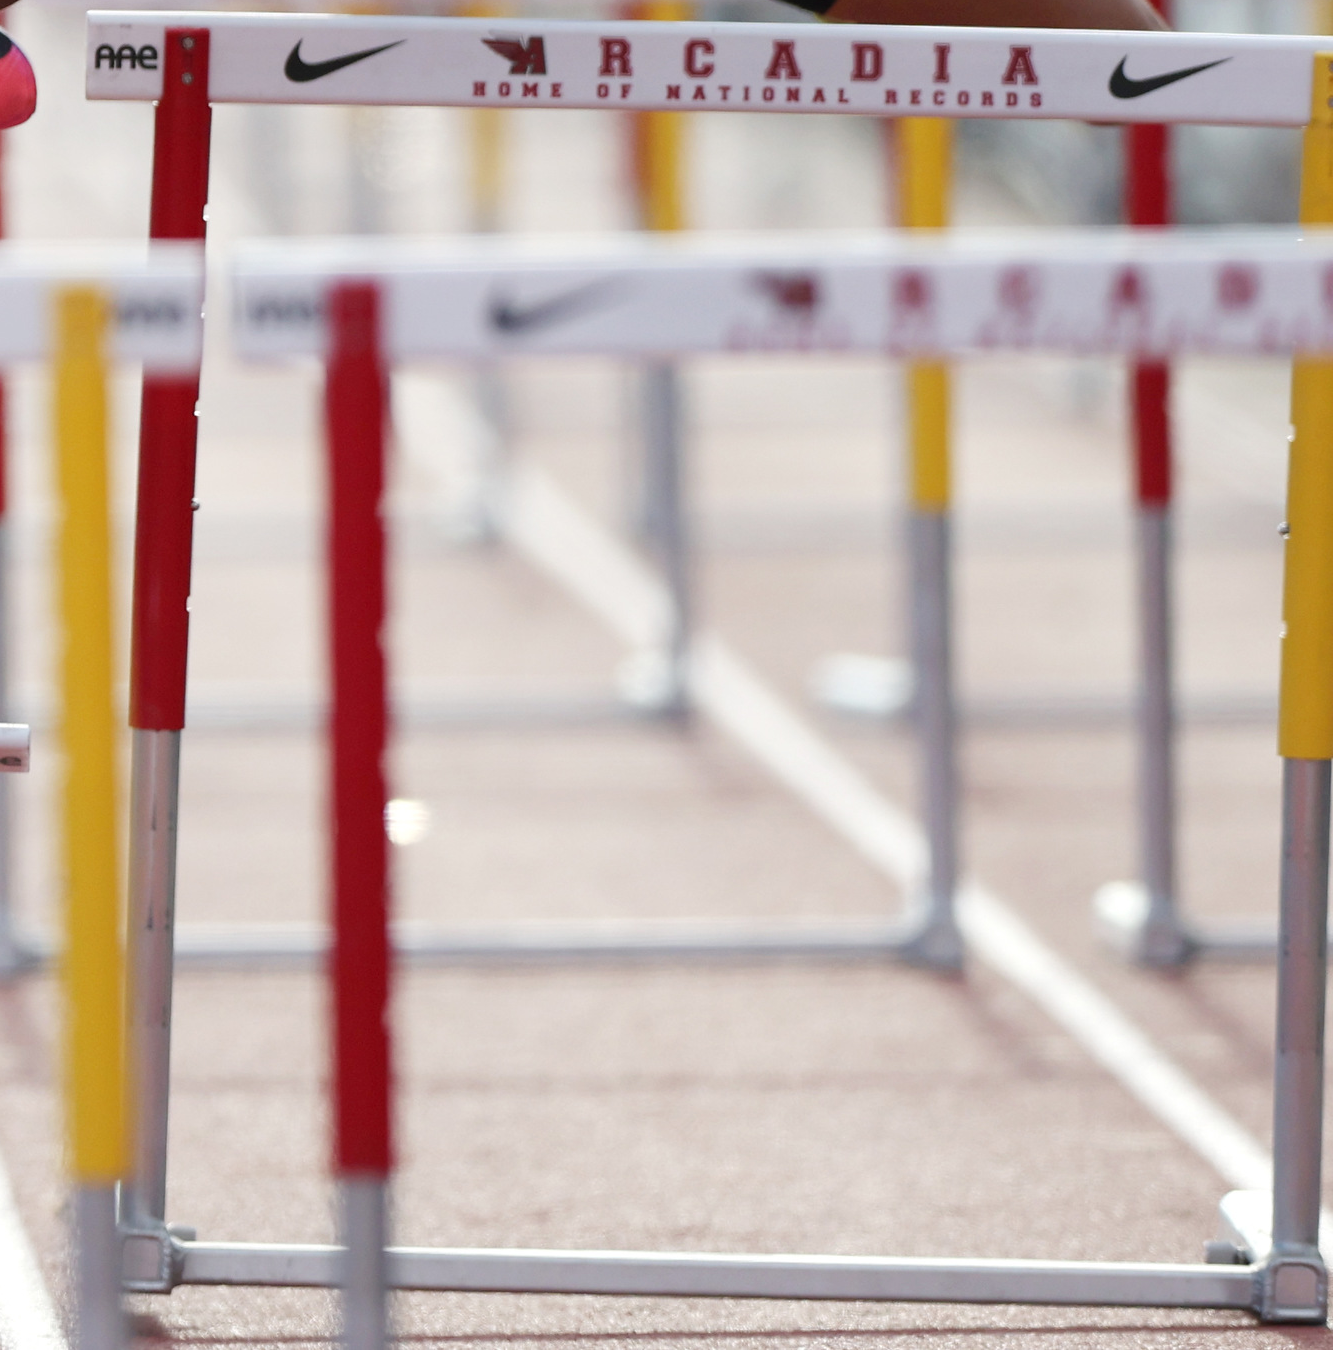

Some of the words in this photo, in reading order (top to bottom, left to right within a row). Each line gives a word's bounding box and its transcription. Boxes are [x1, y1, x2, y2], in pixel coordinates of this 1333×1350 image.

[472, 81, 563, 99] HOME
[596, 83, 633, 99] OF
[667, 83, 850, 105] NATIONAL
[885, 89, 1043, 107] RECORDS
